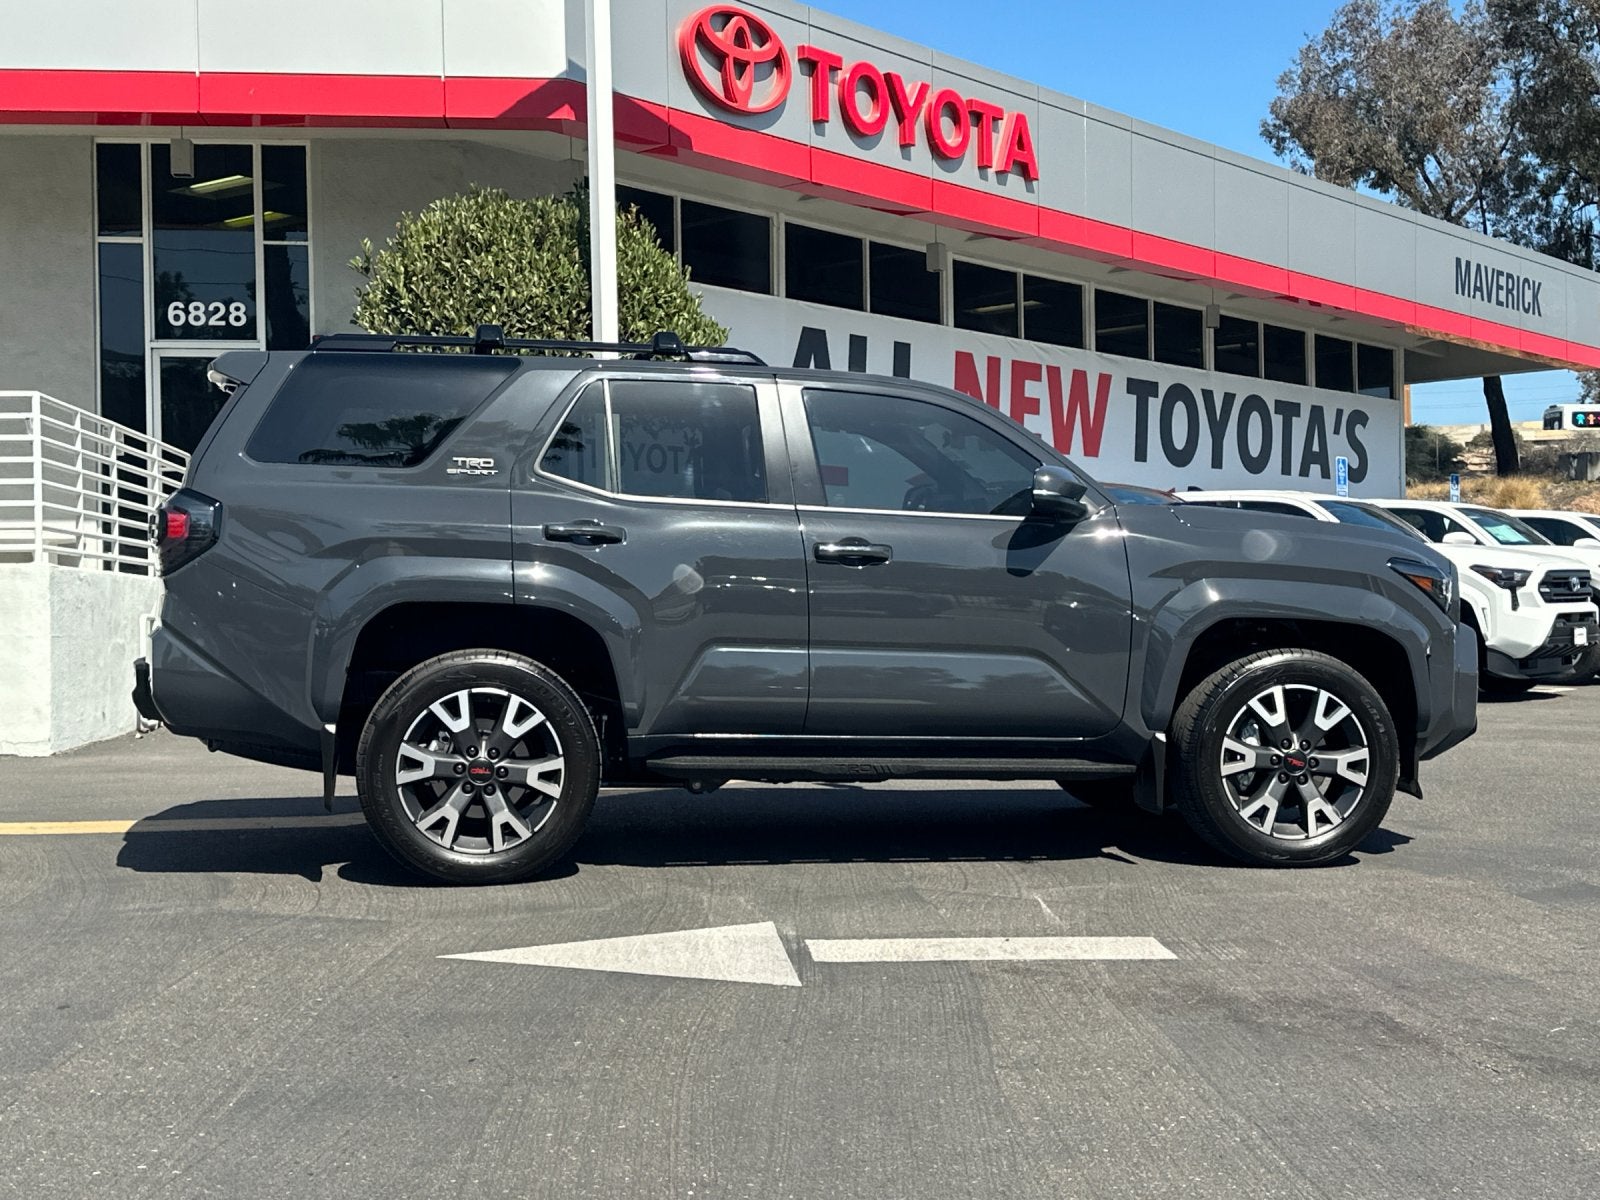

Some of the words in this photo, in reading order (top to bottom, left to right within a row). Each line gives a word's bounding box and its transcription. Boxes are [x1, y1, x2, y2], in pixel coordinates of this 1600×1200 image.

[797, 44, 1039, 181] TOYOTA
[1455, 256, 1542, 317] MAVERICK
[167, 301, 248, 327] 6828
[1126, 377, 1370, 484] TOYOTA'S
[446, 468, 499, 476] SPORT
[452, 456, 495, 469] TRD
